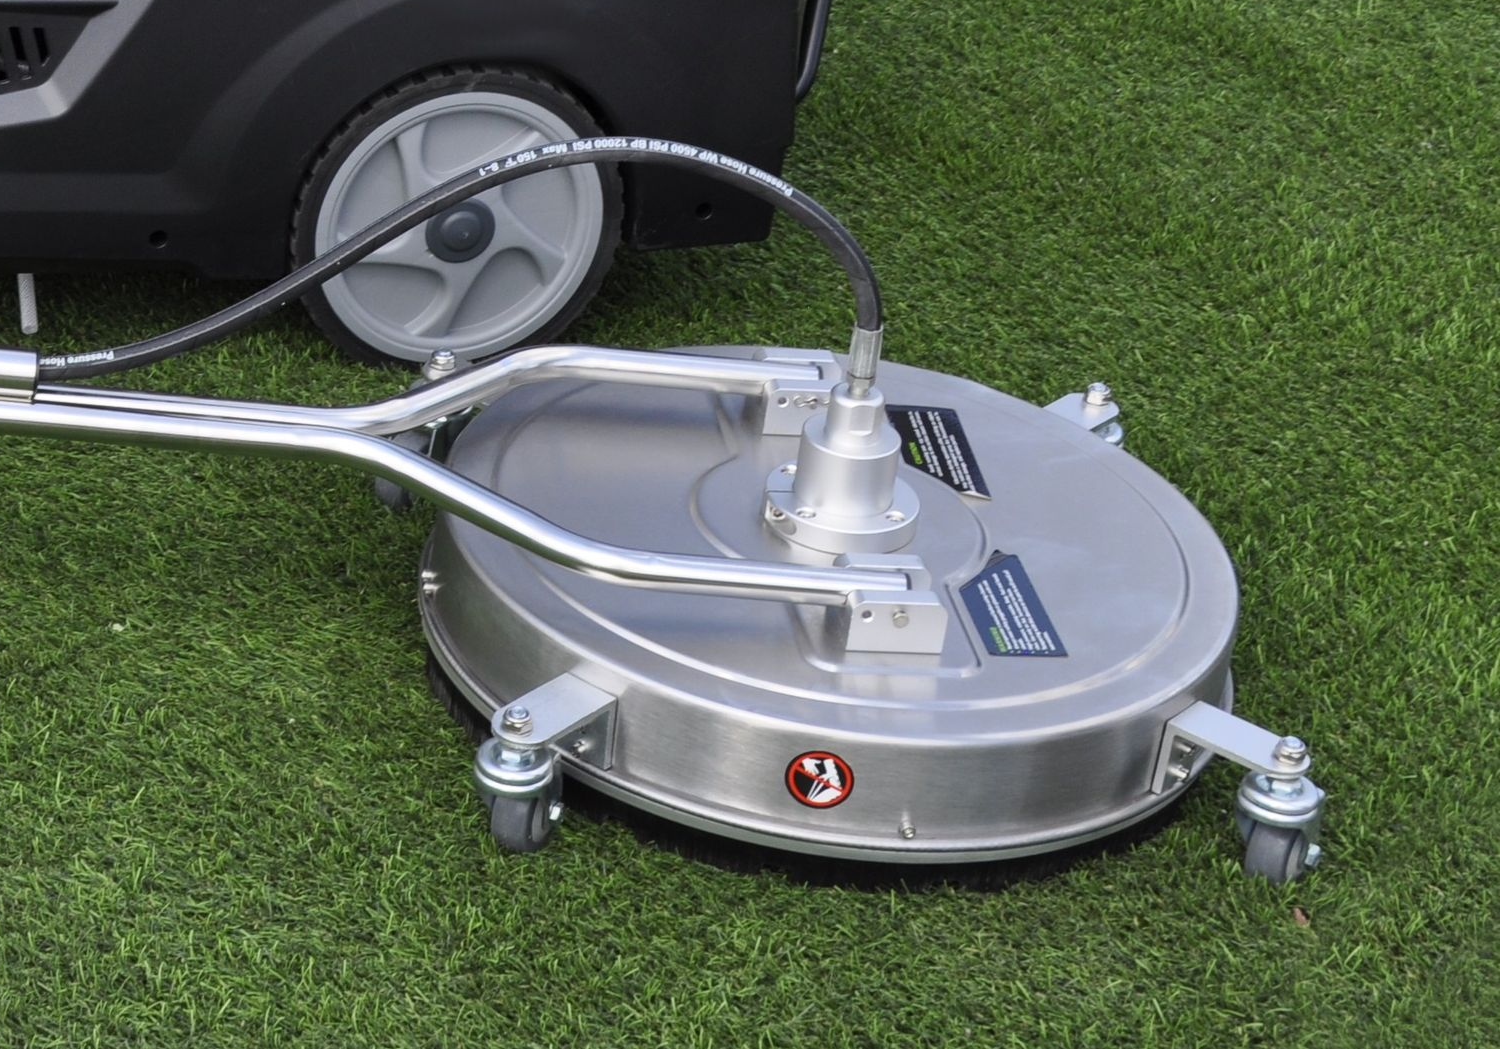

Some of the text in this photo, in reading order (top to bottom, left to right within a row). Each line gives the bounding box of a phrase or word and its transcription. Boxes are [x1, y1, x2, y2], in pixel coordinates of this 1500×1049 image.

[542, 143, 568, 154] Max
[572, 140, 593, 151] PSI
[594, 138, 628, 149] 12000
[630, 139, 647, 150] BP
[649, 140, 670, 152] PSI
[670, 144, 698, 156] 4500
[699, 150, 719, 164] WP
[719, 157, 748, 175] Hose
[749, 166, 794, 197] Pressure
[67, 350, 115, 364] Pressure
